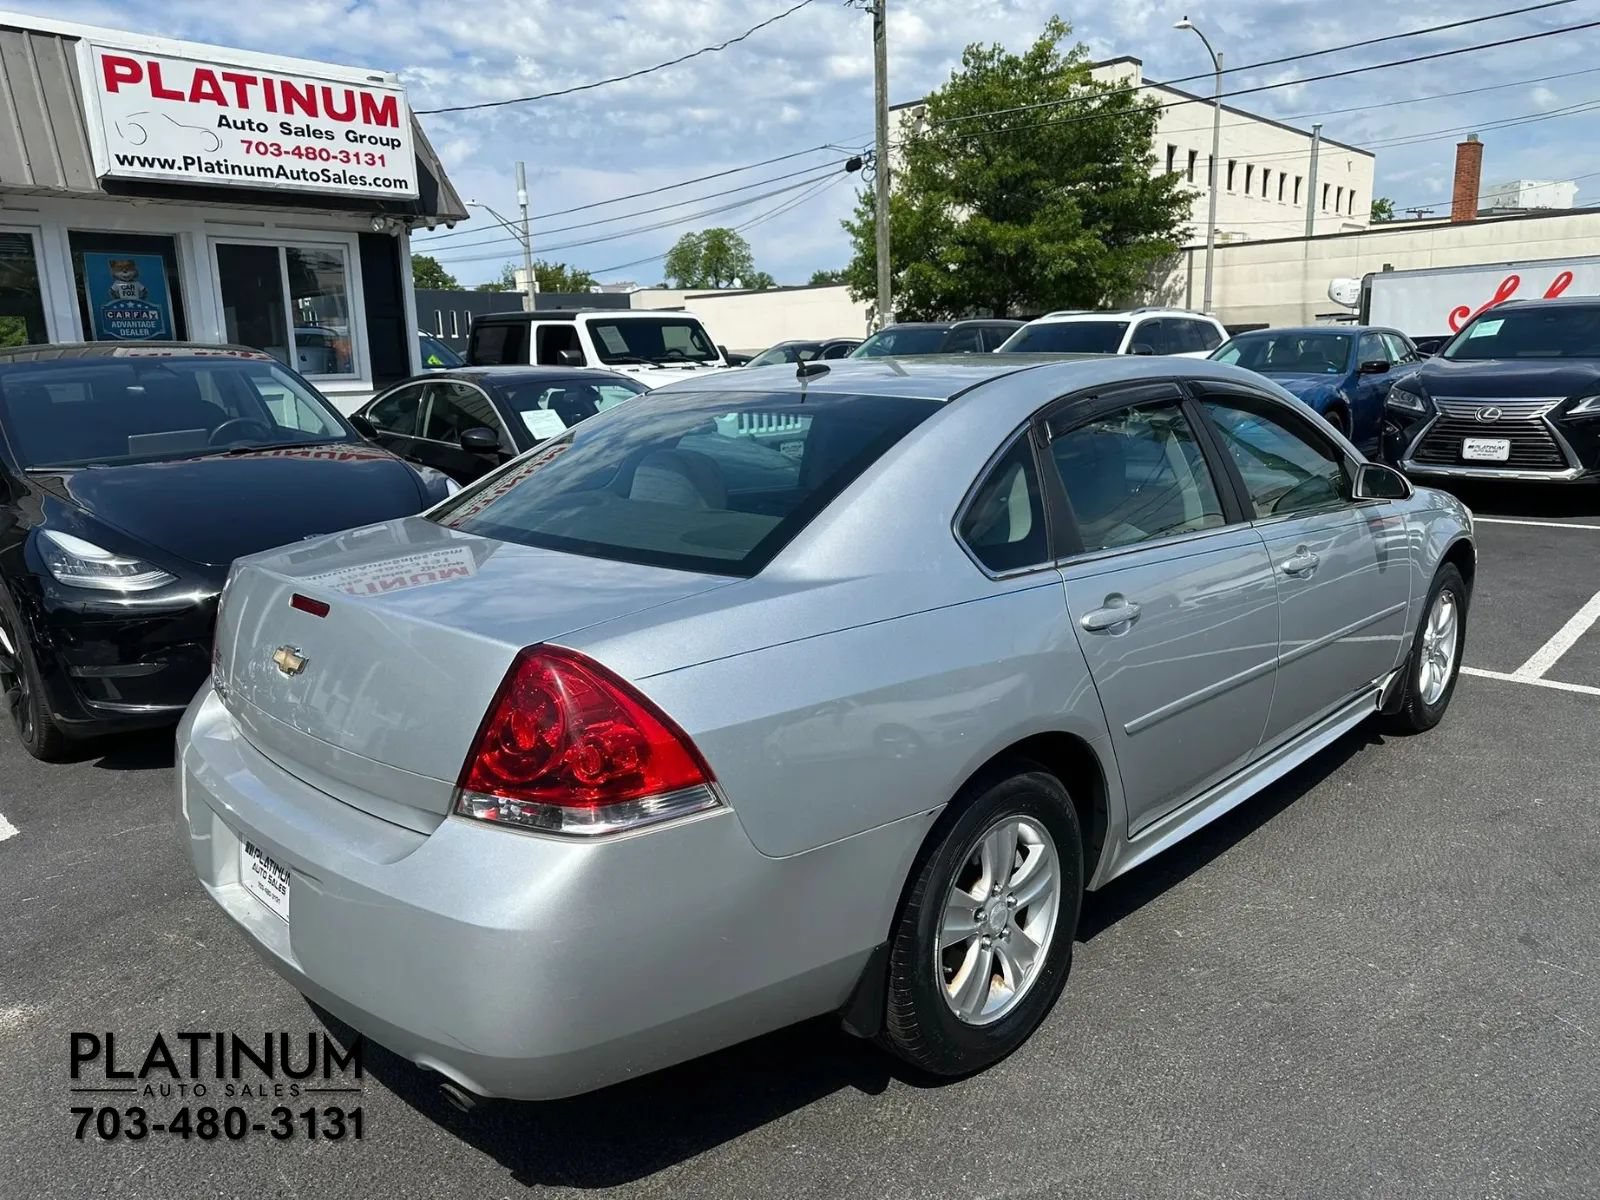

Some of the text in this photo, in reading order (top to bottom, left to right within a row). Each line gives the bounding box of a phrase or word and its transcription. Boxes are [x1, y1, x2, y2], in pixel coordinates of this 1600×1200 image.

[101, 54, 400, 128] PLATINUM
[217, 114, 402, 150] Auto Sales Group
[240, 139, 386, 168] 703-480-3131
[115, 153, 409, 190] www.PlatinumAutoSales.com
[106, 310, 159, 320] CARFAX
[111, 320, 157, 329] ADVANTAGE
[120, 328, 150, 337] DEALER
[251, 863, 287, 896] AUTO SALES
